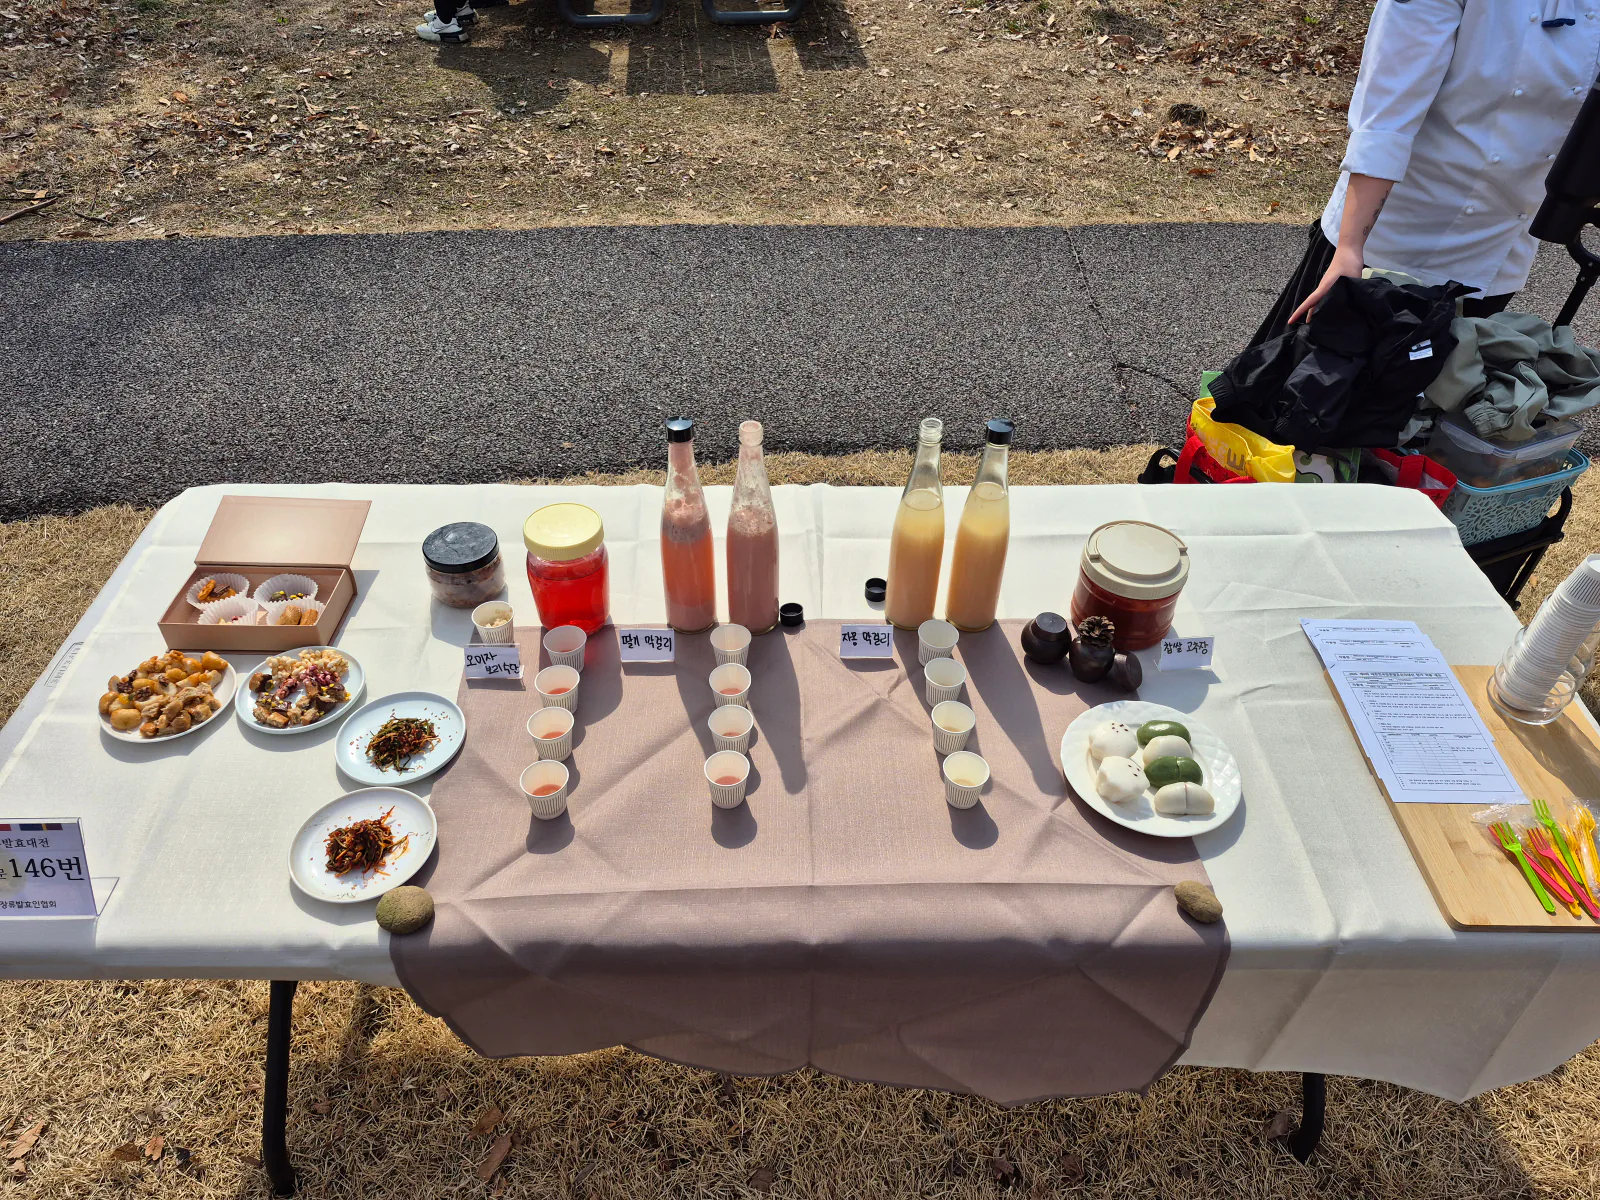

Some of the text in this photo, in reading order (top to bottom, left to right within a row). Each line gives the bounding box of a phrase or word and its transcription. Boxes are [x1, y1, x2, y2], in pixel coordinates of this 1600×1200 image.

[621, 633, 672, 653] 딸기 막걸리
[841, 631, 890, 647] 자몽 막걸리
[1163, 641, 1209, 655] 찹쌀 고추장
[466, 651, 497, 667] 오미자
[0, 837, 50, 849] 발효대전
